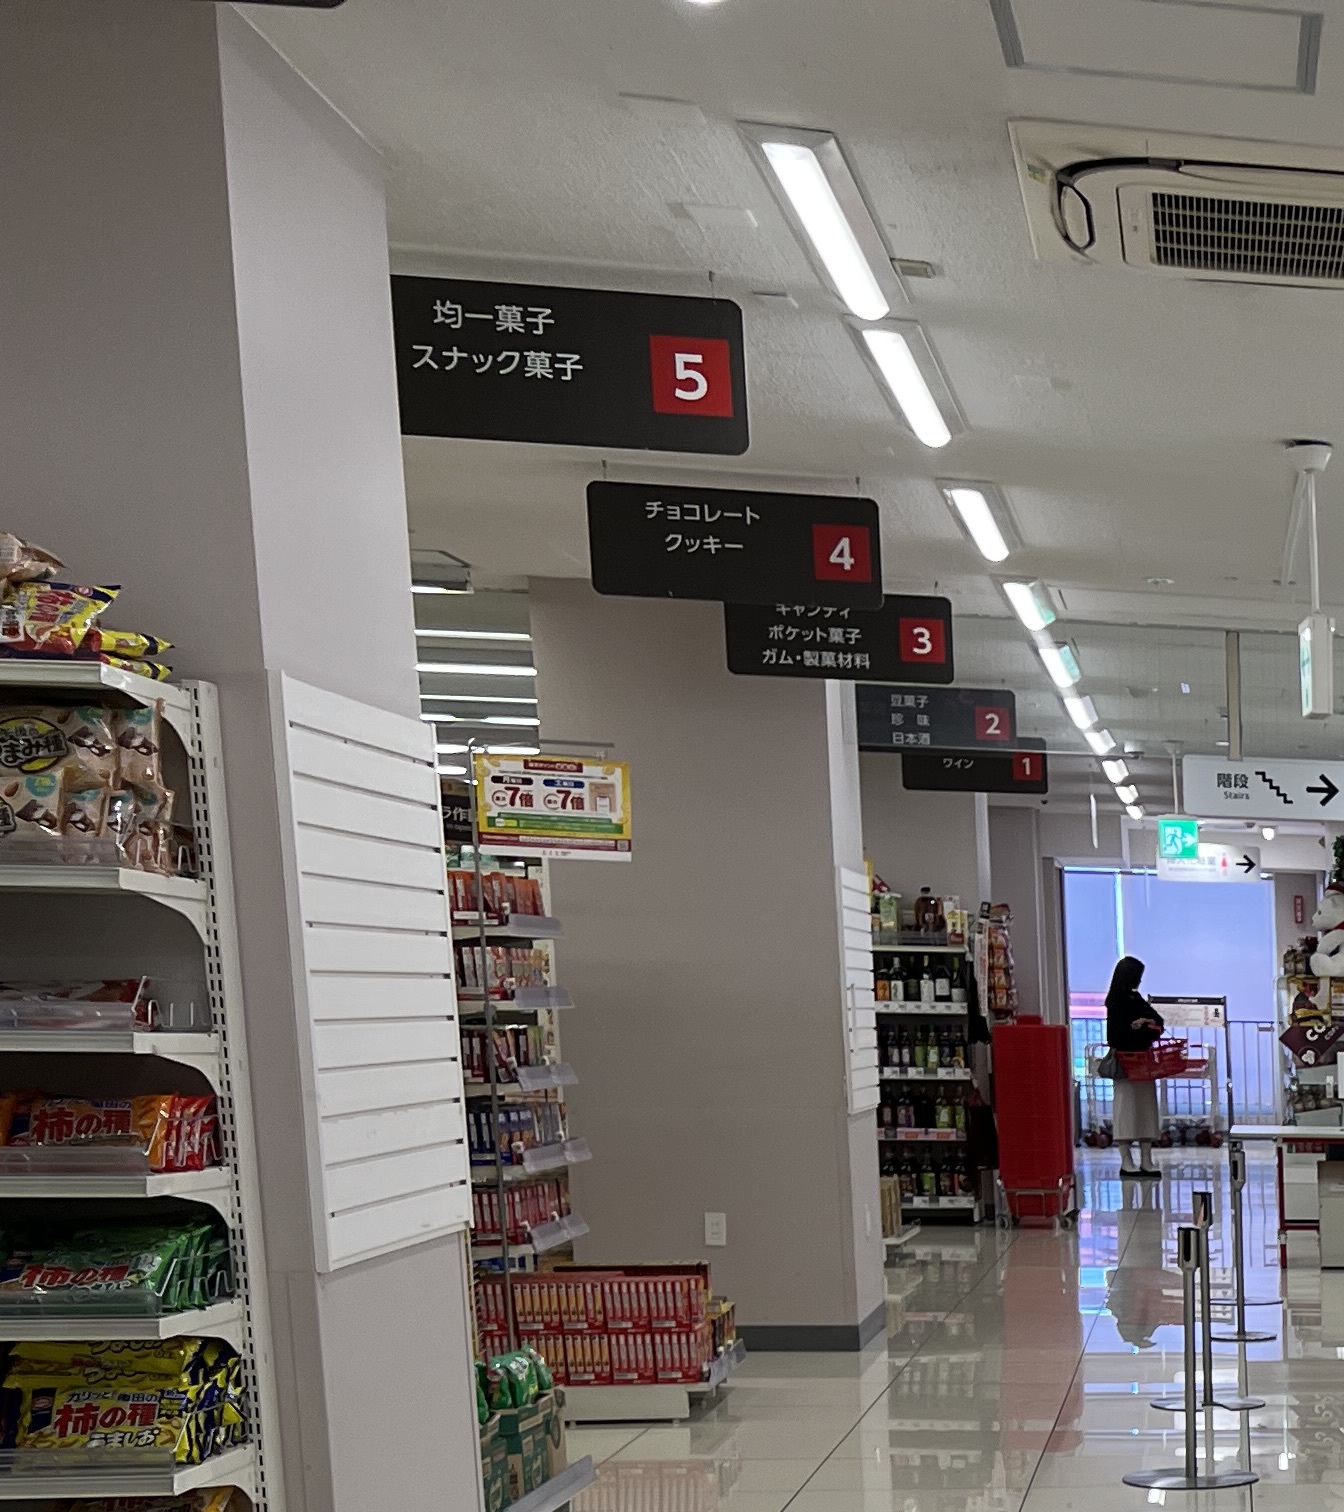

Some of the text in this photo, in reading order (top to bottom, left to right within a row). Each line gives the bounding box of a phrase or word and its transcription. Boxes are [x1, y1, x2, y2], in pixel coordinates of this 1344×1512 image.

[432, 300, 556, 336] 均一菓子
[411, 342, 584, 382] スナック菓子
[671, 351, 710, 402] 5
[644, 500, 762, 526] チョコレート
[664, 532, 745, 556] クッキー
[828, 537, 856, 572] 4
[767, 623, 863, 645] ポケット菓子
[911, 626, 933, 655] 3
[761, 647, 872, 671] ガム・製菓材料
[984, 712, 1001, 735] 2
[891, 731, 931, 745] 日本酒
[942, 757, 975, 769] ワイン
[1021, 757, 1031, 776] 1
[1216, 772, 1249, 789] 階段
[1223, 790, 1250, 801] Stairs
[33, 1107, 132, 1145] 柿の種
[22, 1264, 129, 1287] 柿の種
[54, 1402, 159, 1438] 柿の種
